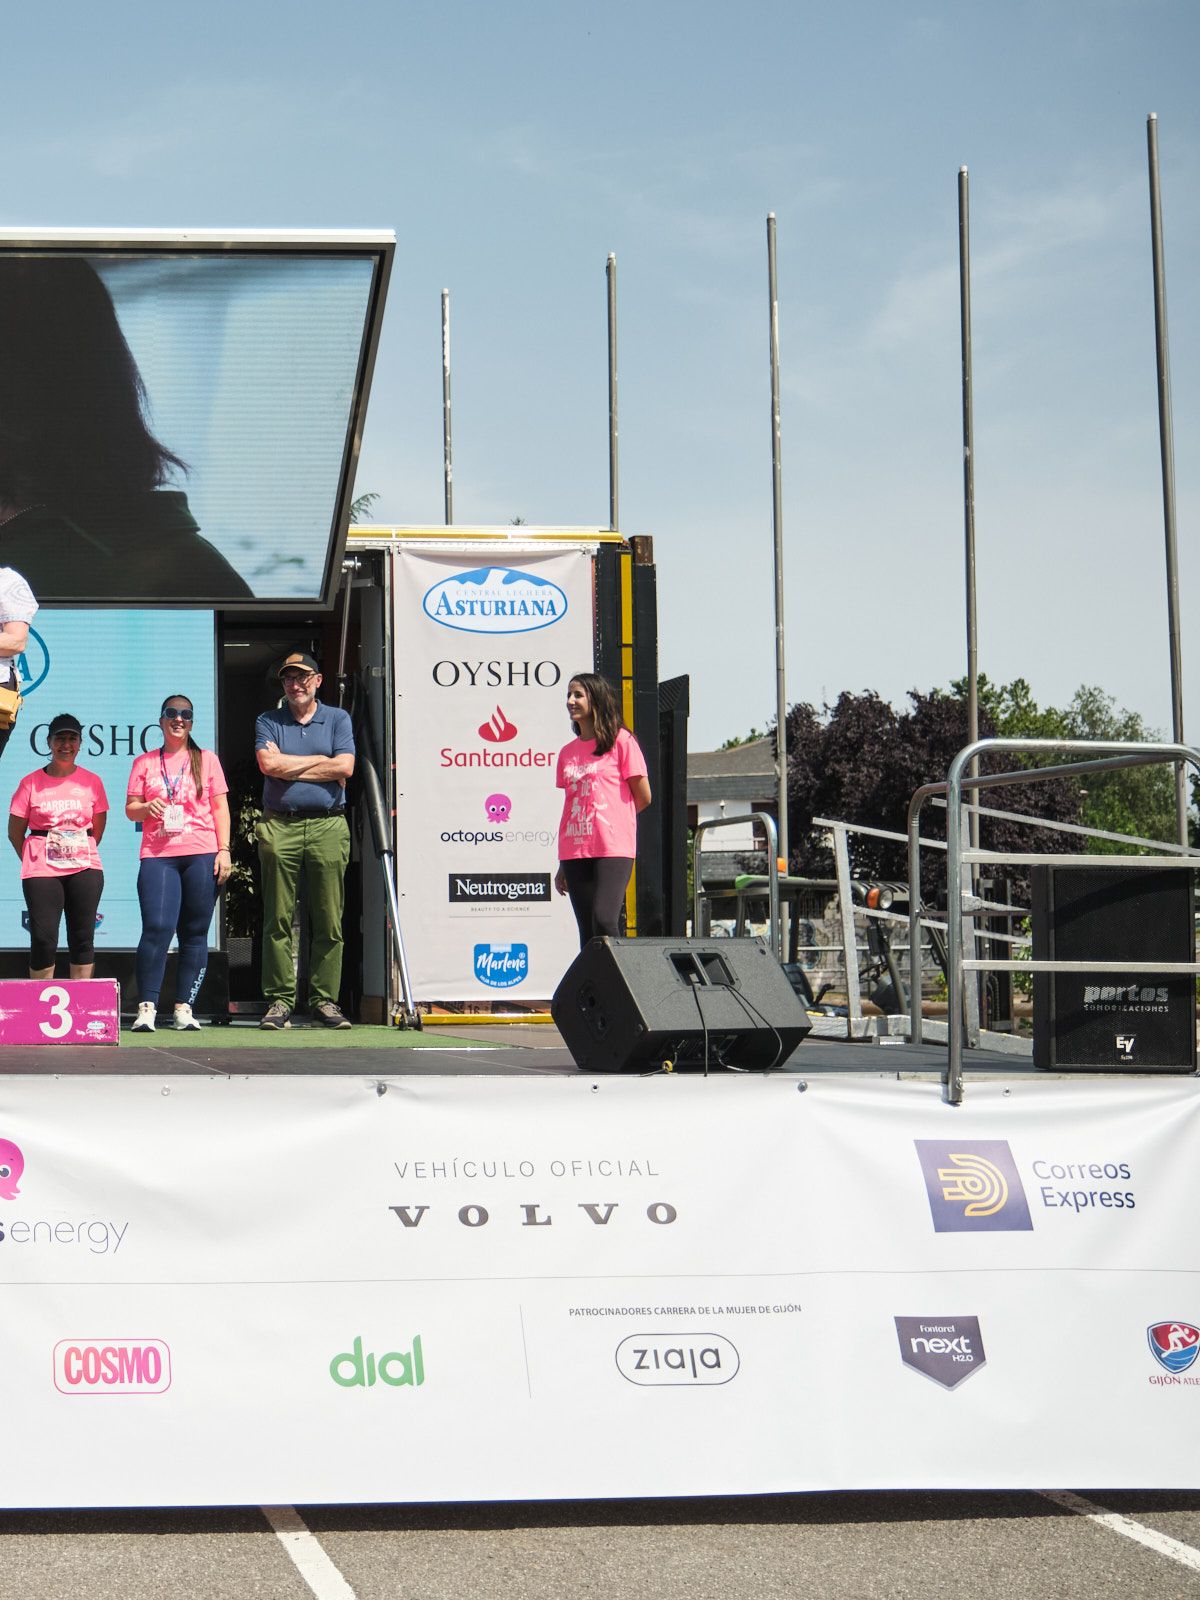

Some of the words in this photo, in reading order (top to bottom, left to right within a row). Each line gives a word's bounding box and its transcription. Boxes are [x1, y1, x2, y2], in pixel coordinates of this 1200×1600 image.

[434, 591, 558, 616] ASTURIANA
[432, 660, 561, 687] OYSHO
[29, 723, 165, 756] OSHO
[440, 748, 555, 767] Santander
[441, 829, 503, 846] octopus
[505, 830, 558, 847] energy
[455, 878, 544, 899] Neutrogena
[477, 952, 526, 977] Marlene
[188, 967, 207, 1004] adidas
[38, 986, 73, 1039] 3
[393, 1157, 536, 1179] VEHÍCULO
[550, 1159, 660, 1177] OFICIAL
[1032, 1160, 1131, 1180] Correos
[1040, 1186, 1136, 1213] Express
[388, 1202, 678, 1228] VOLVO
[11, 1220, 129, 1254] energy
[569, 1307, 652, 1316] PATROCINADORES
[654, 1306, 696, 1315] CARRERA
[698, 1306, 711, 1315] DE
[712, 1306, 724, 1314] LA
[726, 1305, 757, 1314] MUJER
[758, 1305, 771, 1314] DE
[772, 1303, 802, 1313] GIJÓN
[919, 1324, 955, 1333] Fontarel
[910, 1336, 972, 1355] next
[64, 1345, 162, 1385] COSMO
[329, 1334, 426, 1388] dial
[633, 1347, 722, 1379] ziaja
[1149, 1373, 1181, 1386] GIJÓN
